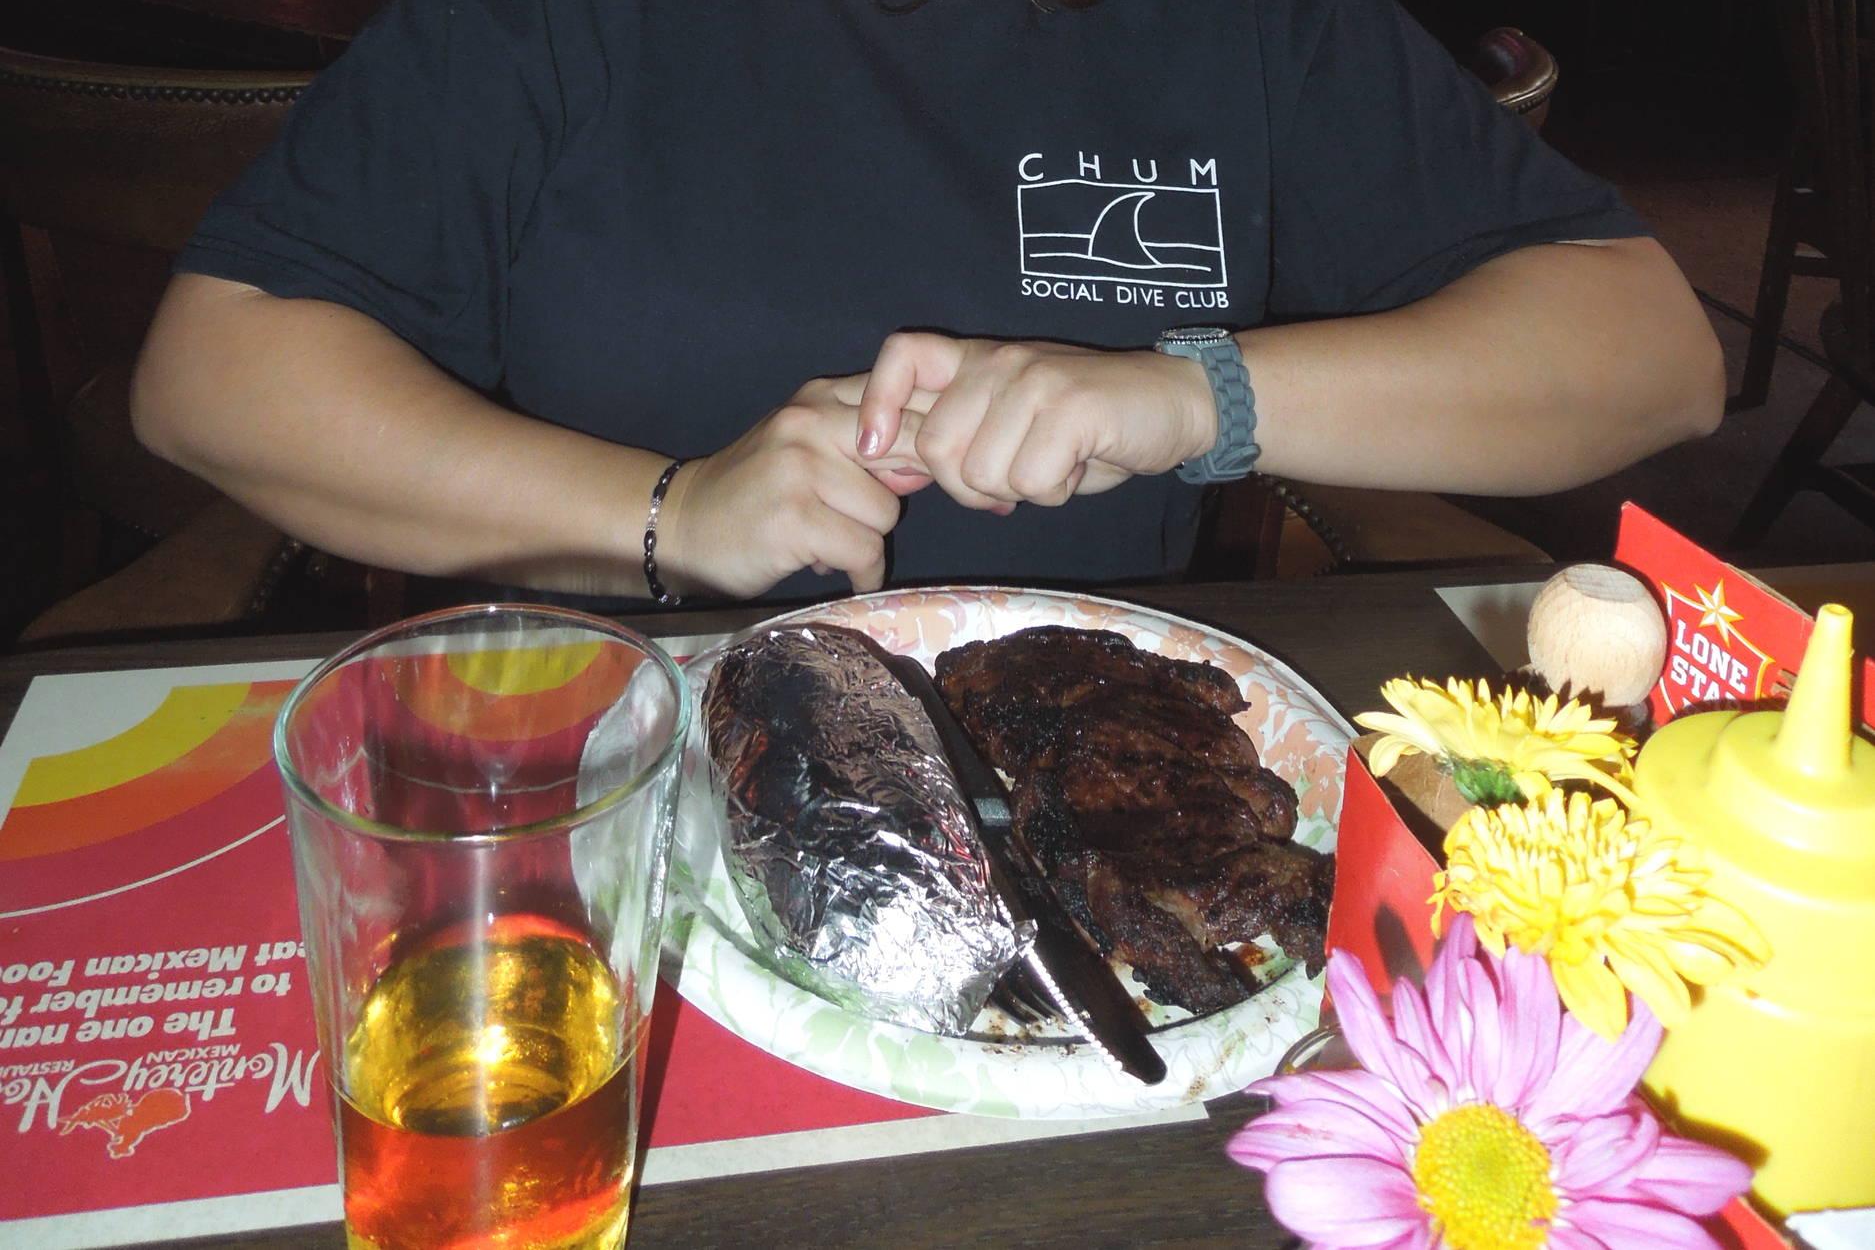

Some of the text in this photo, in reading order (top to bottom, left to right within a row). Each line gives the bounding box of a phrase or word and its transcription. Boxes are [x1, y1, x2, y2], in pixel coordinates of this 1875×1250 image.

[1021, 278, 1230, 309] SOCIAL DIVE CLUB
[1675, 618, 1749, 696] LONE
[1670, 654, 1740, 701] STA
[0, 959, 76, 988] Foo
[84, 944, 249, 981] Mexican
[30, 976, 245, 1018] remember
[251, 972, 292, 997] to
[75, 1015, 154, 1044] one
[163, 1007, 237, 1042] The
[146, 1043, 241, 1064] MEXICAN
[122, 1042, 321, 1113] Monterey
